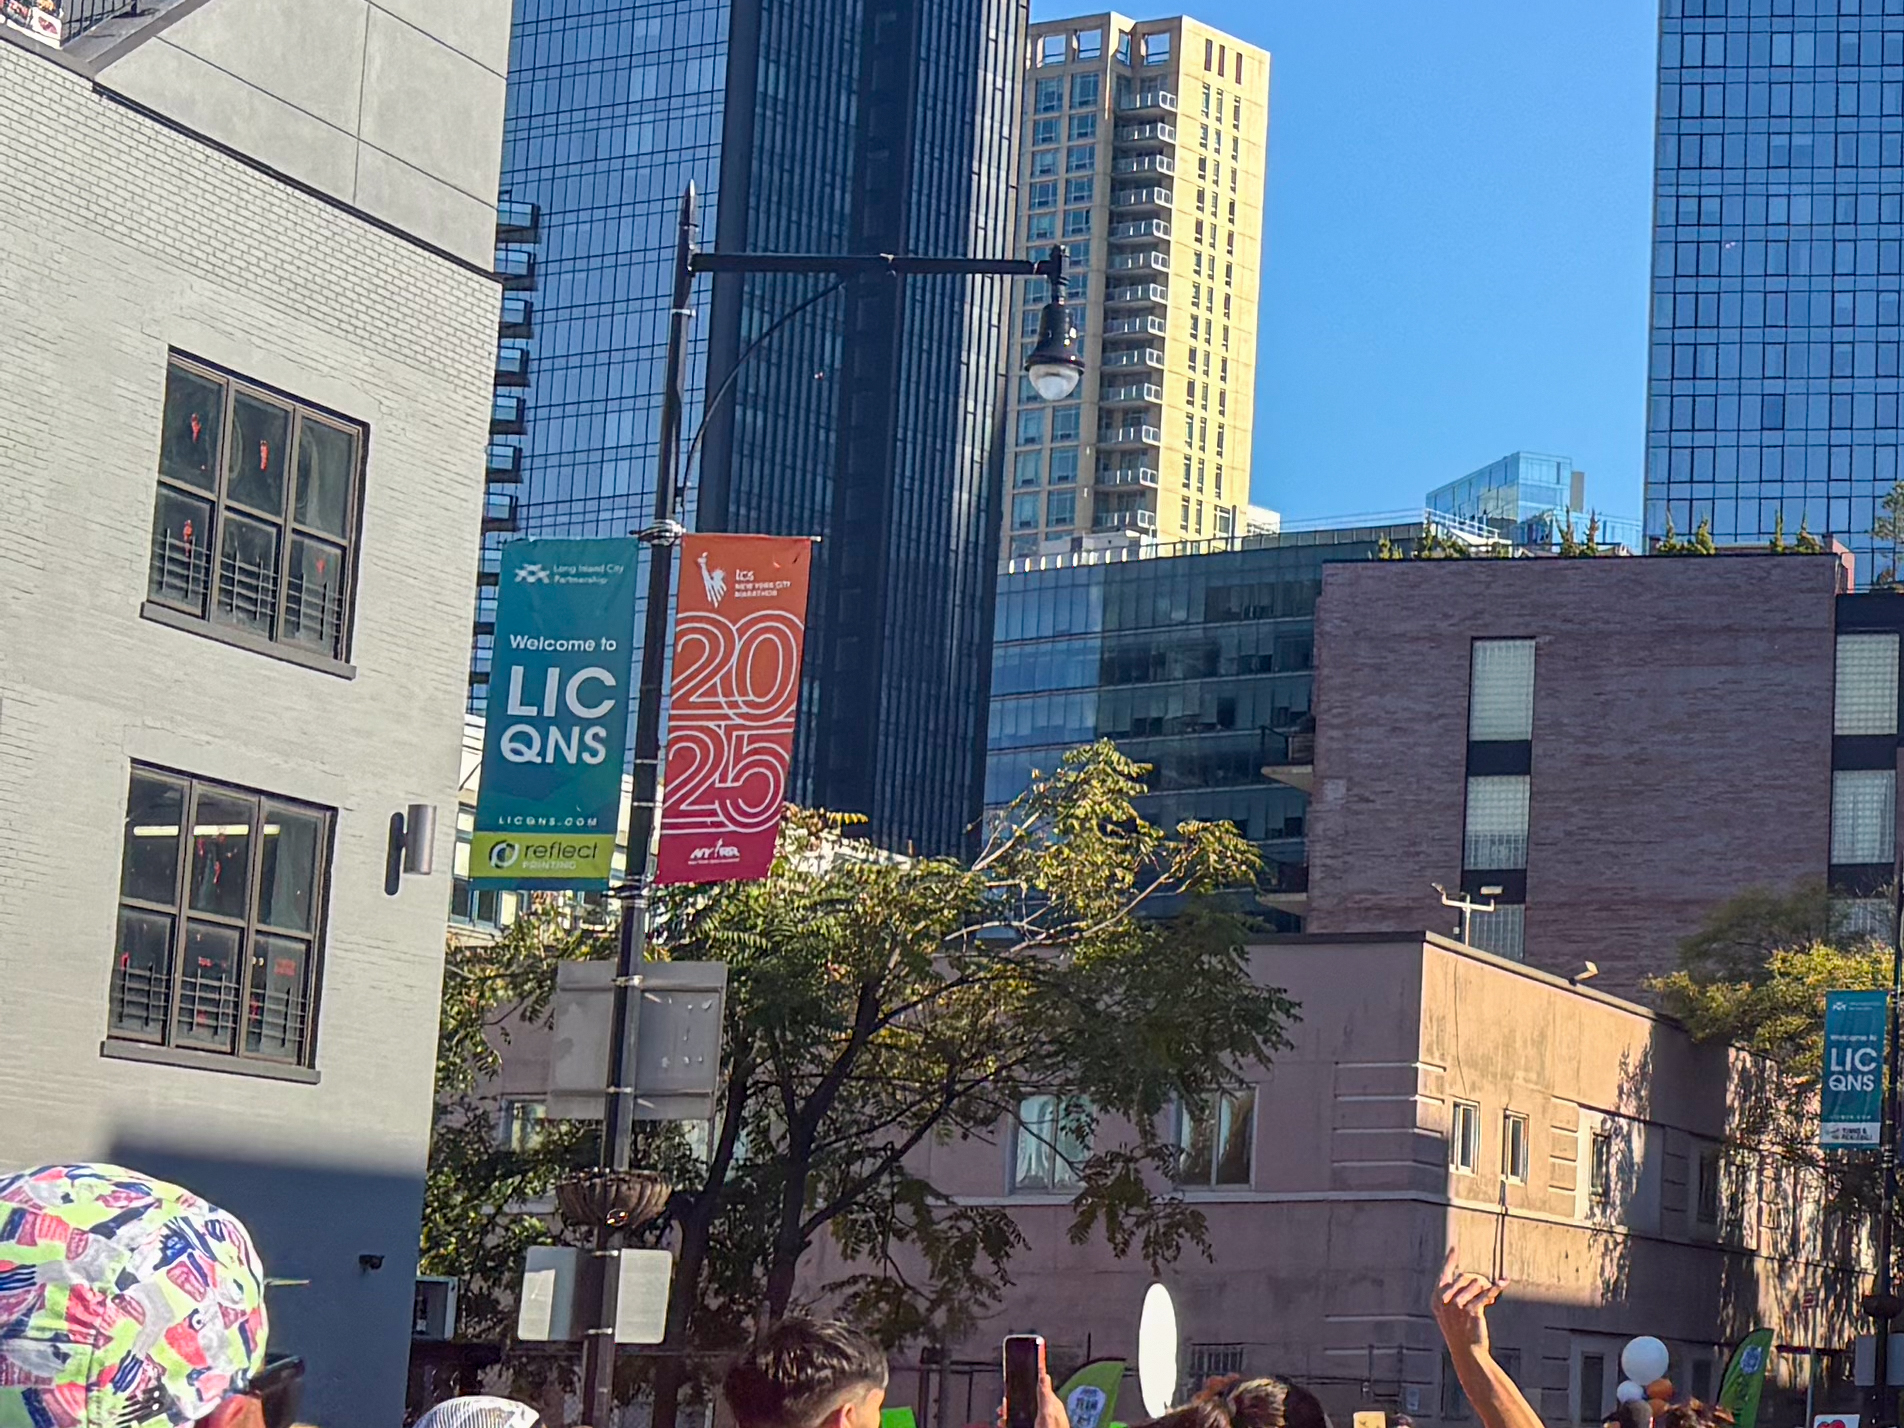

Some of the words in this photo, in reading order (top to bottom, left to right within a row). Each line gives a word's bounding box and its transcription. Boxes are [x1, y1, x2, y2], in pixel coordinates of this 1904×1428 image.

[510, 634, 596, 651] Welcome
[600, 636, 617, 651] to
[670, 610, 804, 726] 20
[506, 665, 617, 719] LIC
[500, 723, 606, 765] QNS
[663, 724, 792, 833] 25
[499, 816, 597, 827] LICQNS.COM
[525, 842, 597, 860] reflect
[522, 861, 577, 870] PRINTING
[1830, 1047, 1878, 1072] LIC
[1829, 1074, 1875, 1092] QNS
